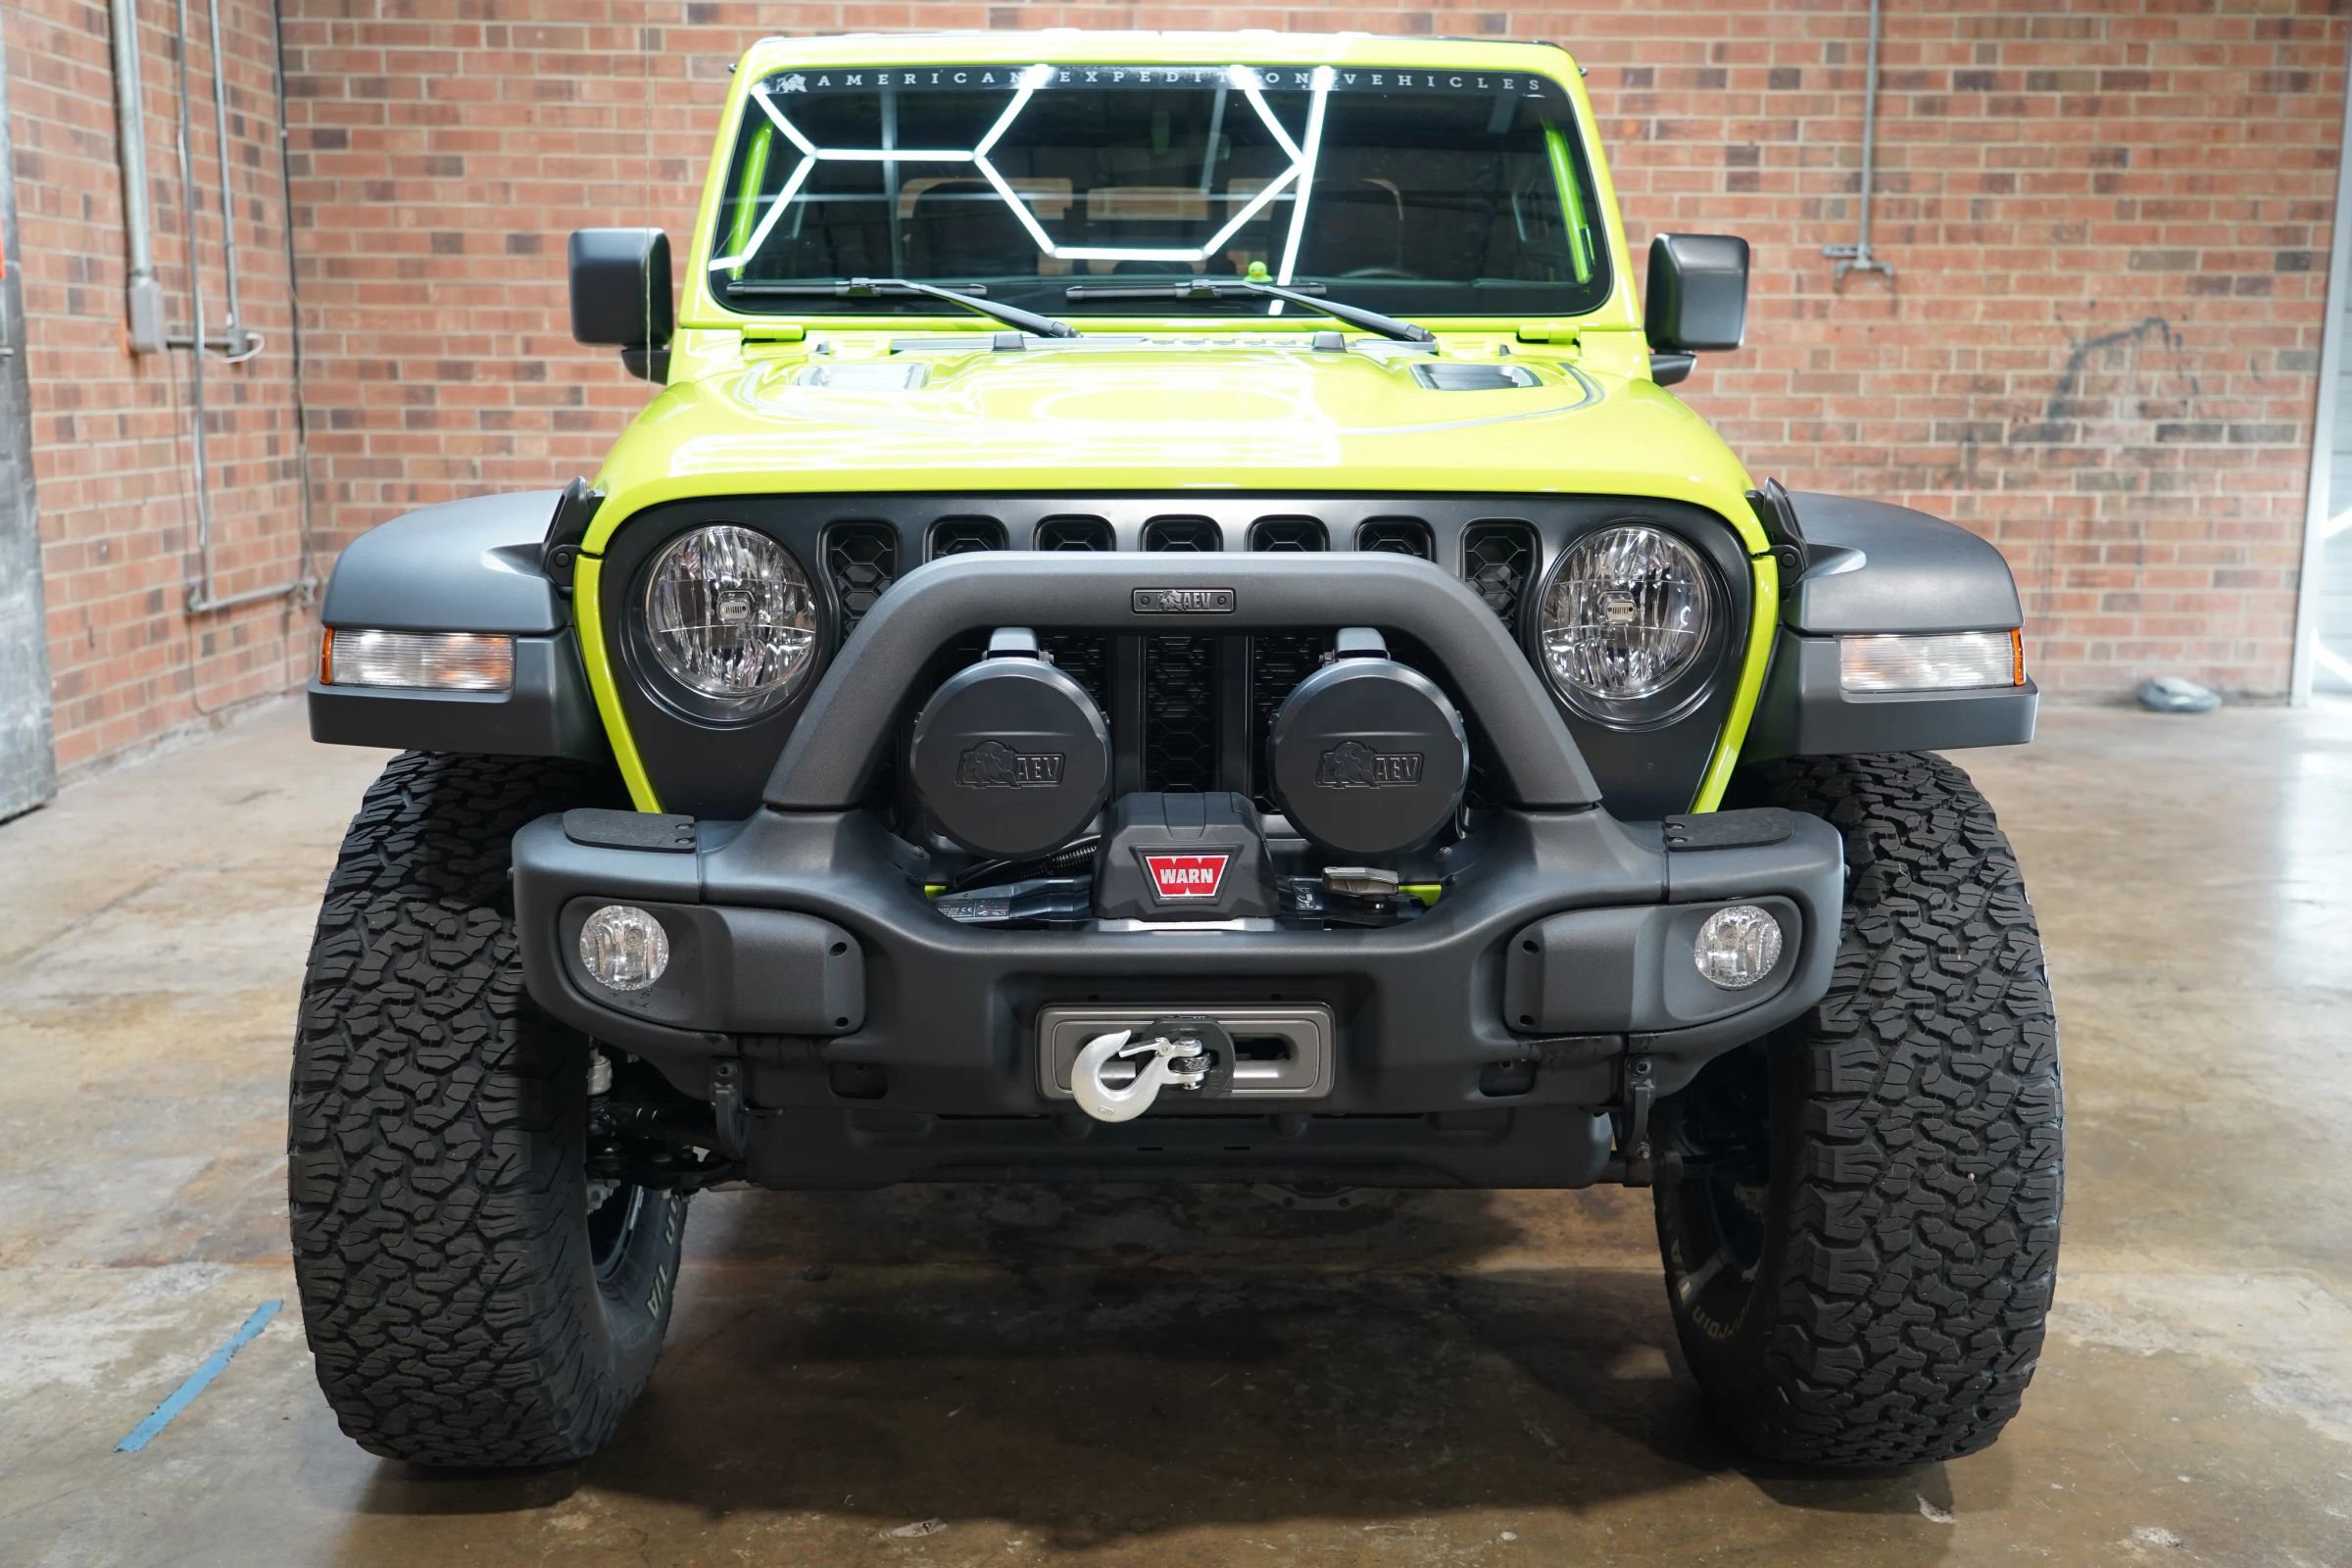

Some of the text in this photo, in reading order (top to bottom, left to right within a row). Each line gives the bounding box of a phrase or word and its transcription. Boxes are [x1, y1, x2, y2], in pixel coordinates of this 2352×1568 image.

[816, 71, 1540, 91] AMERICAN EXPEDITON VEHICLES
[1183, 592, 1211, 609] AEV
[1016, 757, 1059, 781] AEV
[1375, 757, 1418, 781] AEV
[1159, 868, 1214, 884] WARN
